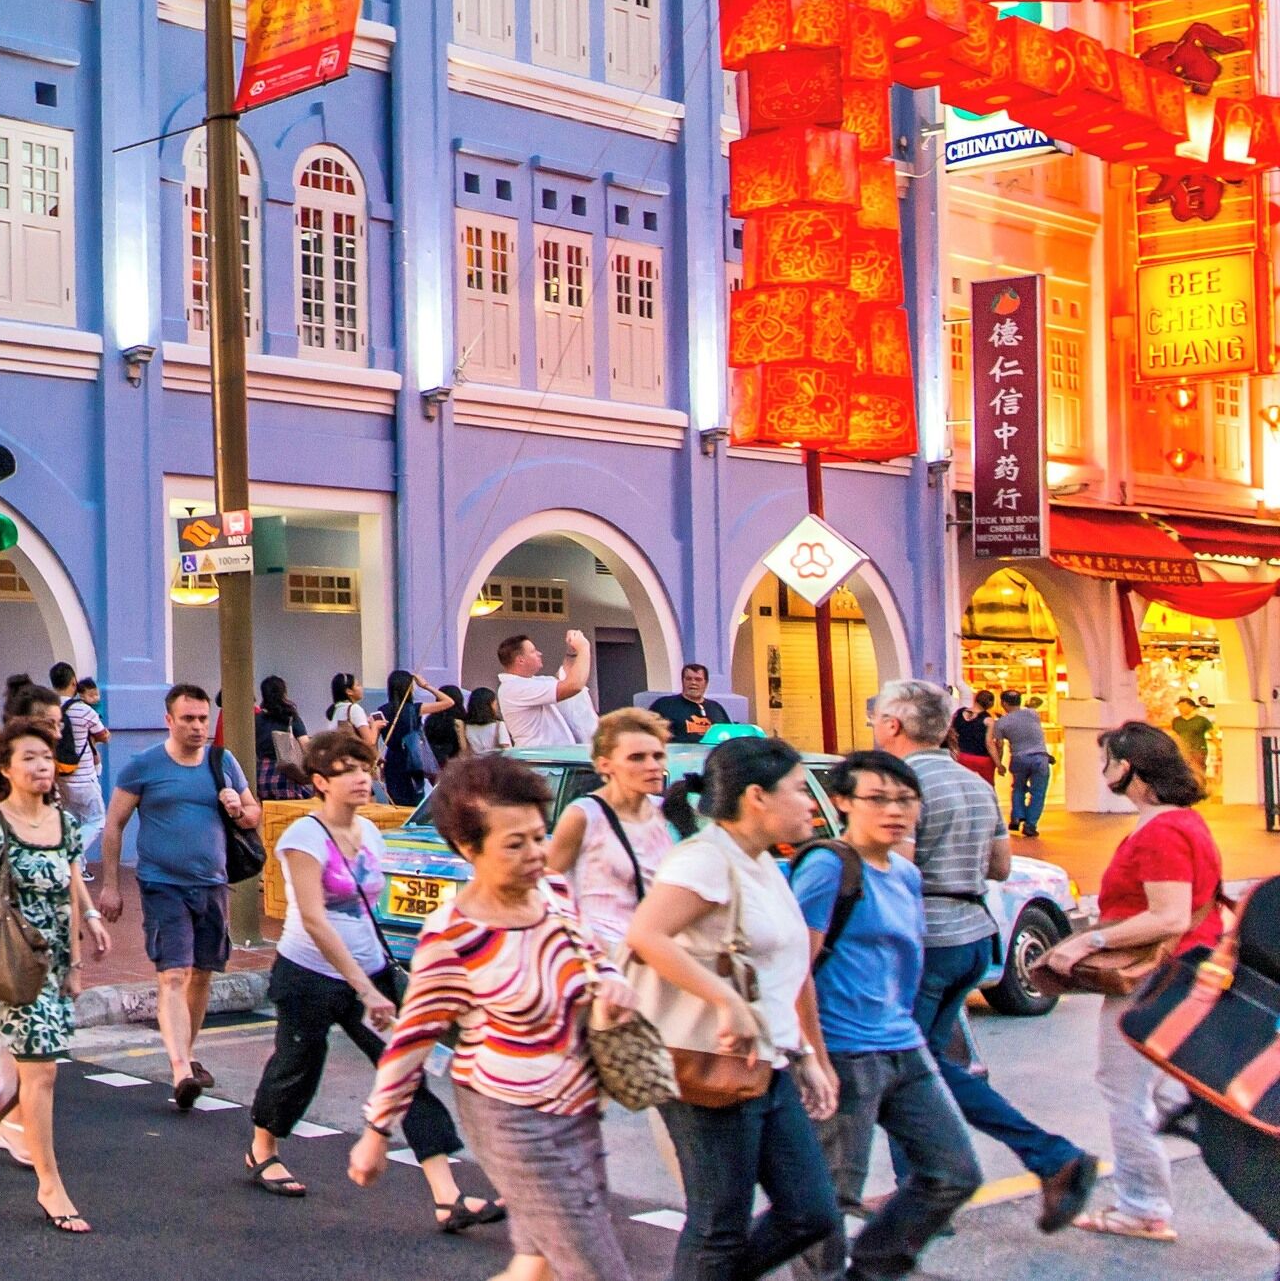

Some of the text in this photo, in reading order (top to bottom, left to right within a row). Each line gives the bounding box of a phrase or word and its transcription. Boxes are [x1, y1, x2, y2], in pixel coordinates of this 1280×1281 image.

[946, 128, 1048, 161] CHINATOWN
[1168, 268, 1221, 298] BEE
[1146, 300, 1248, 335] CHENG
[1148, 336, 1245, 368] HIANG
[988, 319, 1024, 511] 德仁信中药行
[975, 515, 1040, 525] TECK YIN SOON
[989, 525, 1026, 533] CHINESE
[227, 534, 248, 546] MRT
[976, 533, 1038, 542] MEDICAL HALL
[218, 556, 241, 566] 100m
[406, 880, 440, 898] SHB
[393, 895, 443, 915] 7382
